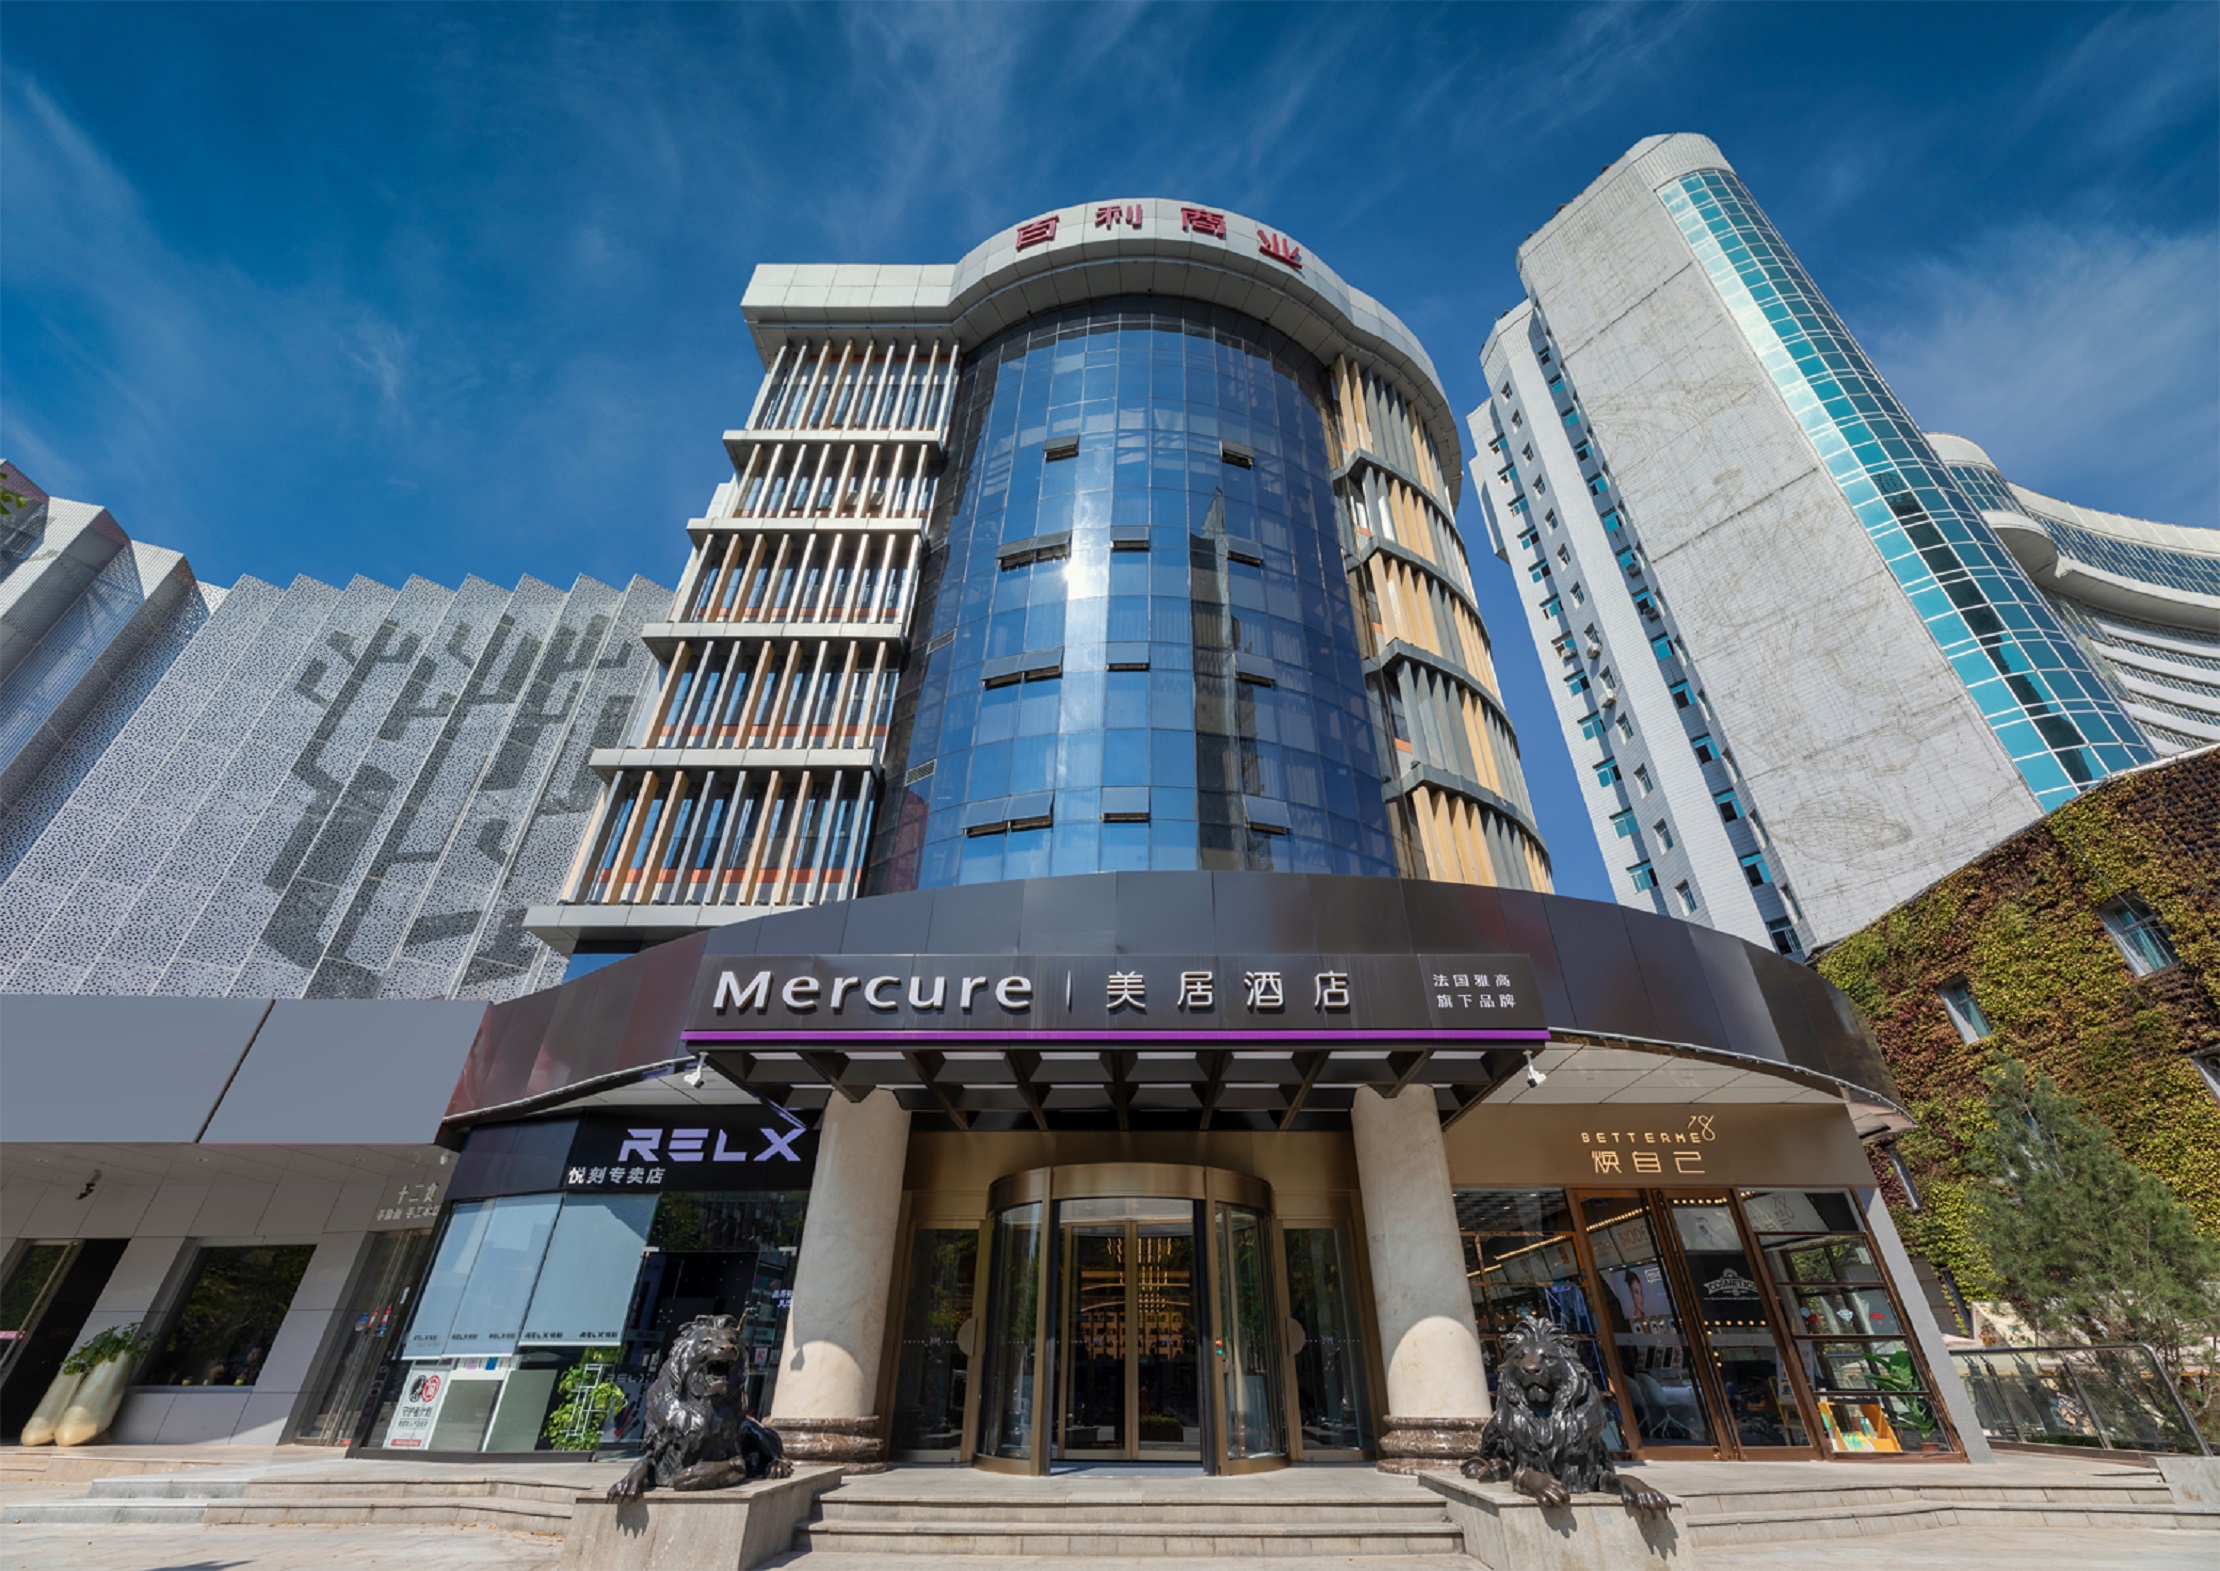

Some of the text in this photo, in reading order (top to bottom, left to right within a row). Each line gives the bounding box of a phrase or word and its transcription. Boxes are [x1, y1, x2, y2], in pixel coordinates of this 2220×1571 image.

[1016, 203, 1302, 269] 百利商业
[1433, 973, 1511, 988] 法国雅高
[713, 971, 1350, 1013] Mercure 美居酒店
[1436, 993, 1517, 1009] 旗下品牌
[618, 1127, 807, 1162] RELX
[1580, 1132, 1702, 1144] BETTERME
[568, 1165, 666, 1185] 悦刻专卖店
